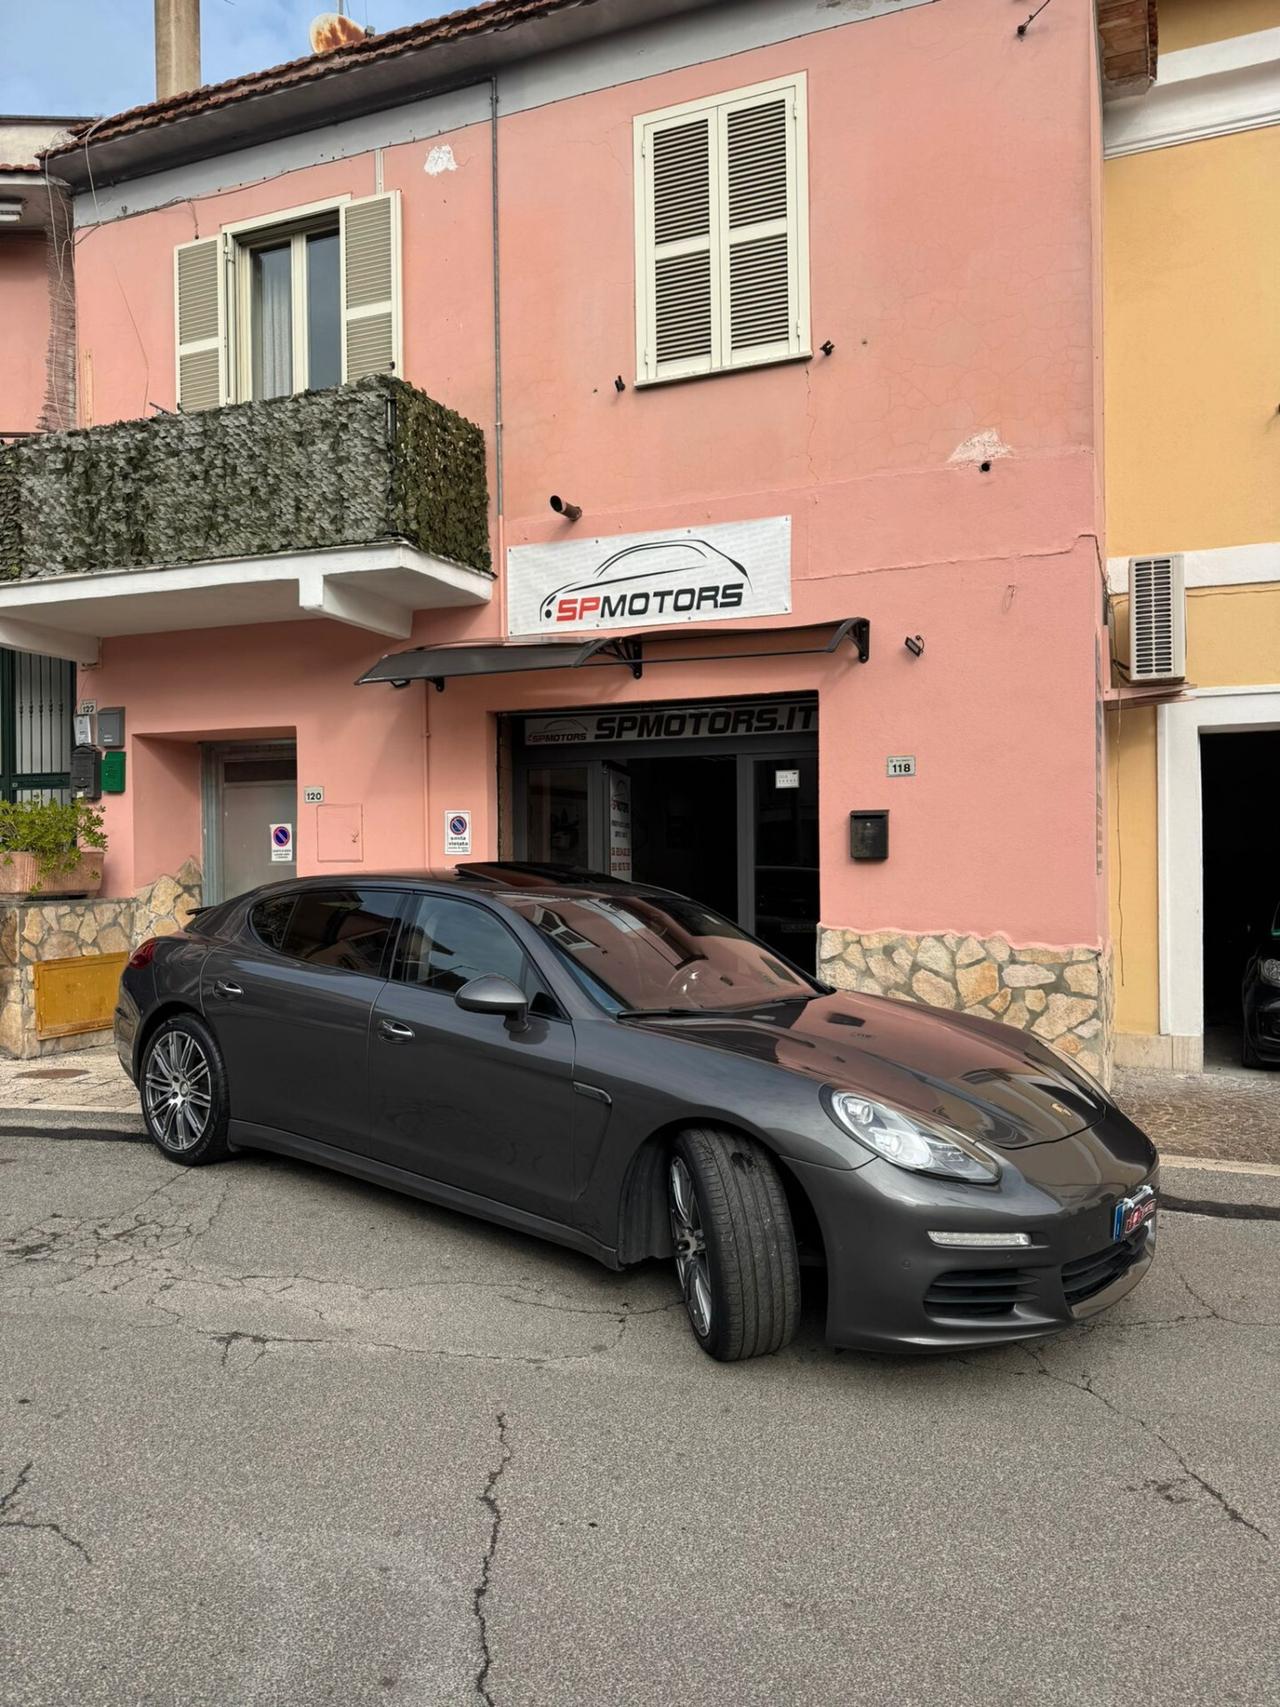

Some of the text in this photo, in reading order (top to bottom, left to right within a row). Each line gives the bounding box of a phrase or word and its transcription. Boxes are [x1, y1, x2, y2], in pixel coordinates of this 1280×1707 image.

[556, 583, 744, 622] SPMOTORS
[594, 705, 818, 741] SPMOTORS.IT
[530, 732, 588, 744] SPMOTORS
[892, 763, 911, 773] 118
[306, 792, 322, 801] 120
